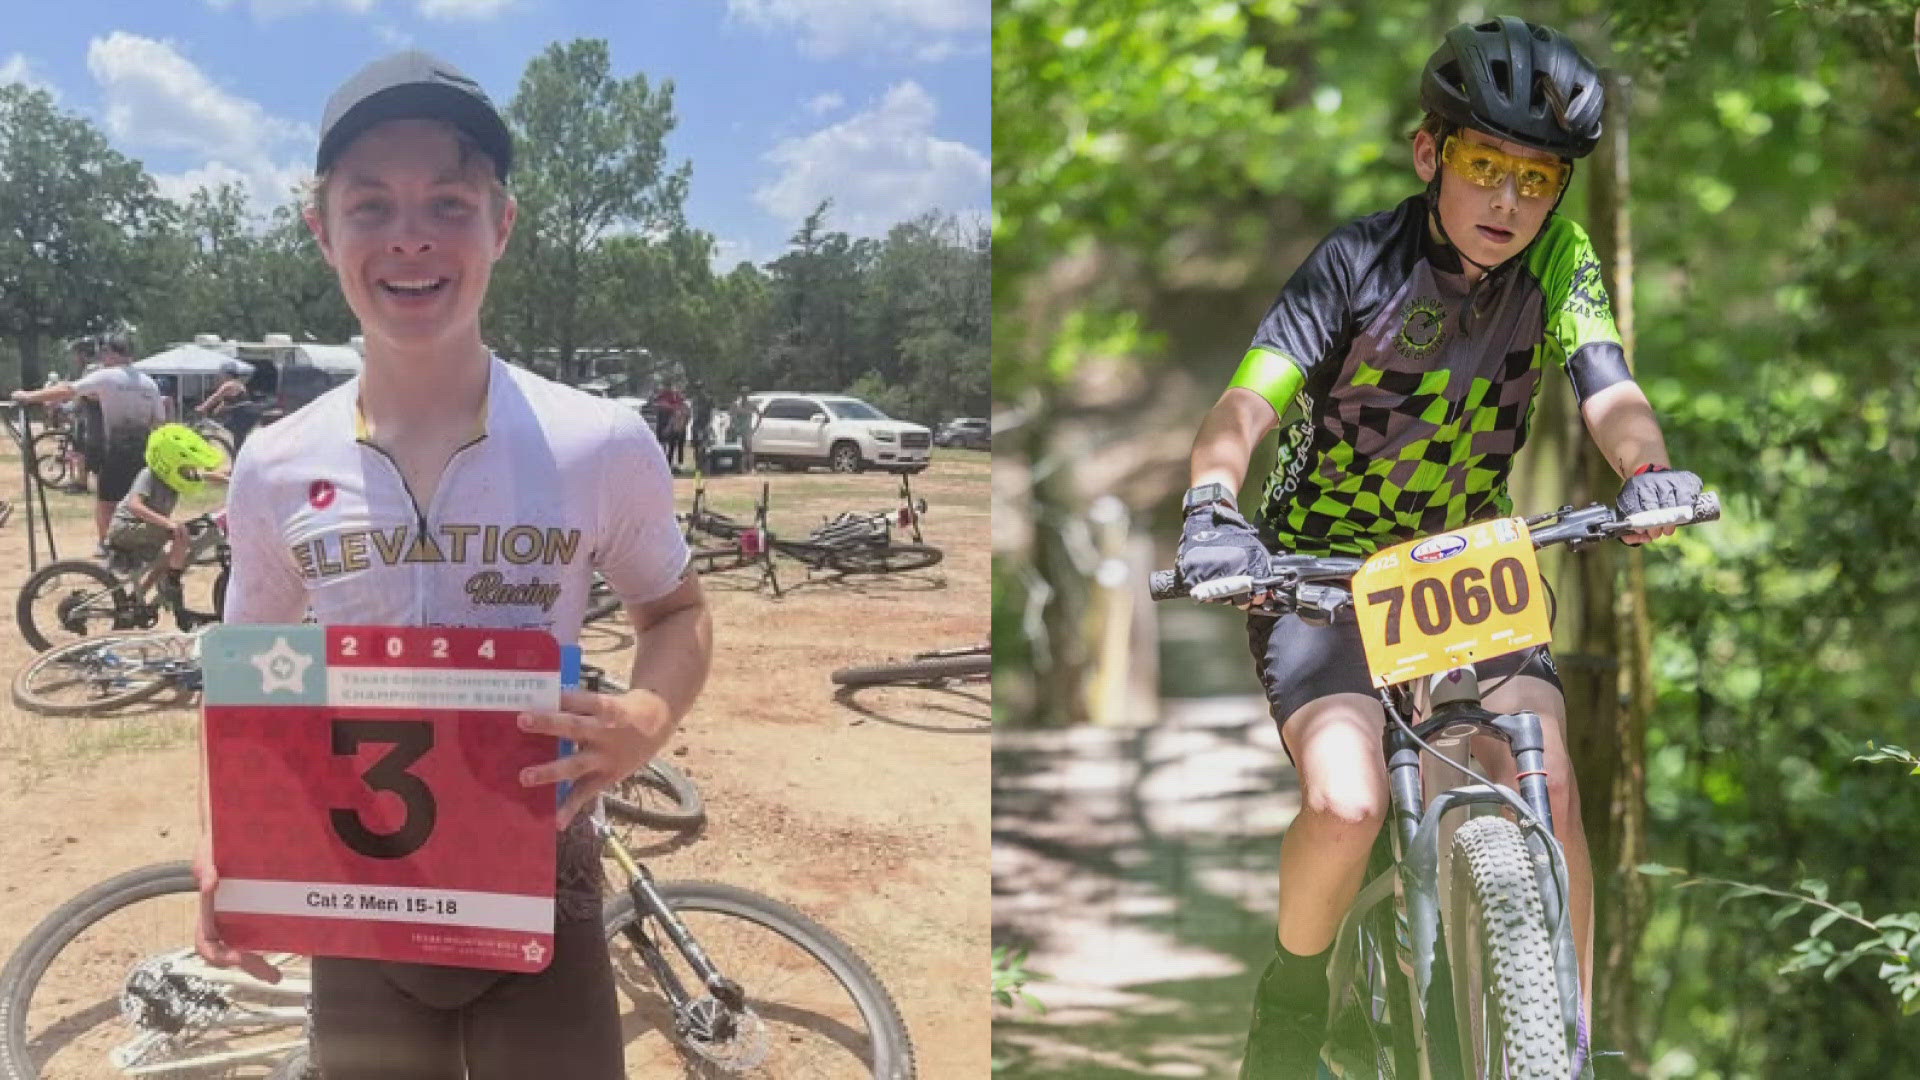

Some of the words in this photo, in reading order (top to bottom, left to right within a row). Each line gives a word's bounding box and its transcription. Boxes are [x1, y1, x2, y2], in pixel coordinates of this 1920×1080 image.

[292, 525, 581, 579] ELEVATION
[465, 571, 561, 611] Racing
[1367, 557, 1530, 647] 7060
[329, 719, 437, 860] 3
[306, 891, 338, 908] Cat
[343, 893, 354, 910] 2
[360, 895, 399, 912] Men
[406, 897, 458, 916] 15-18
